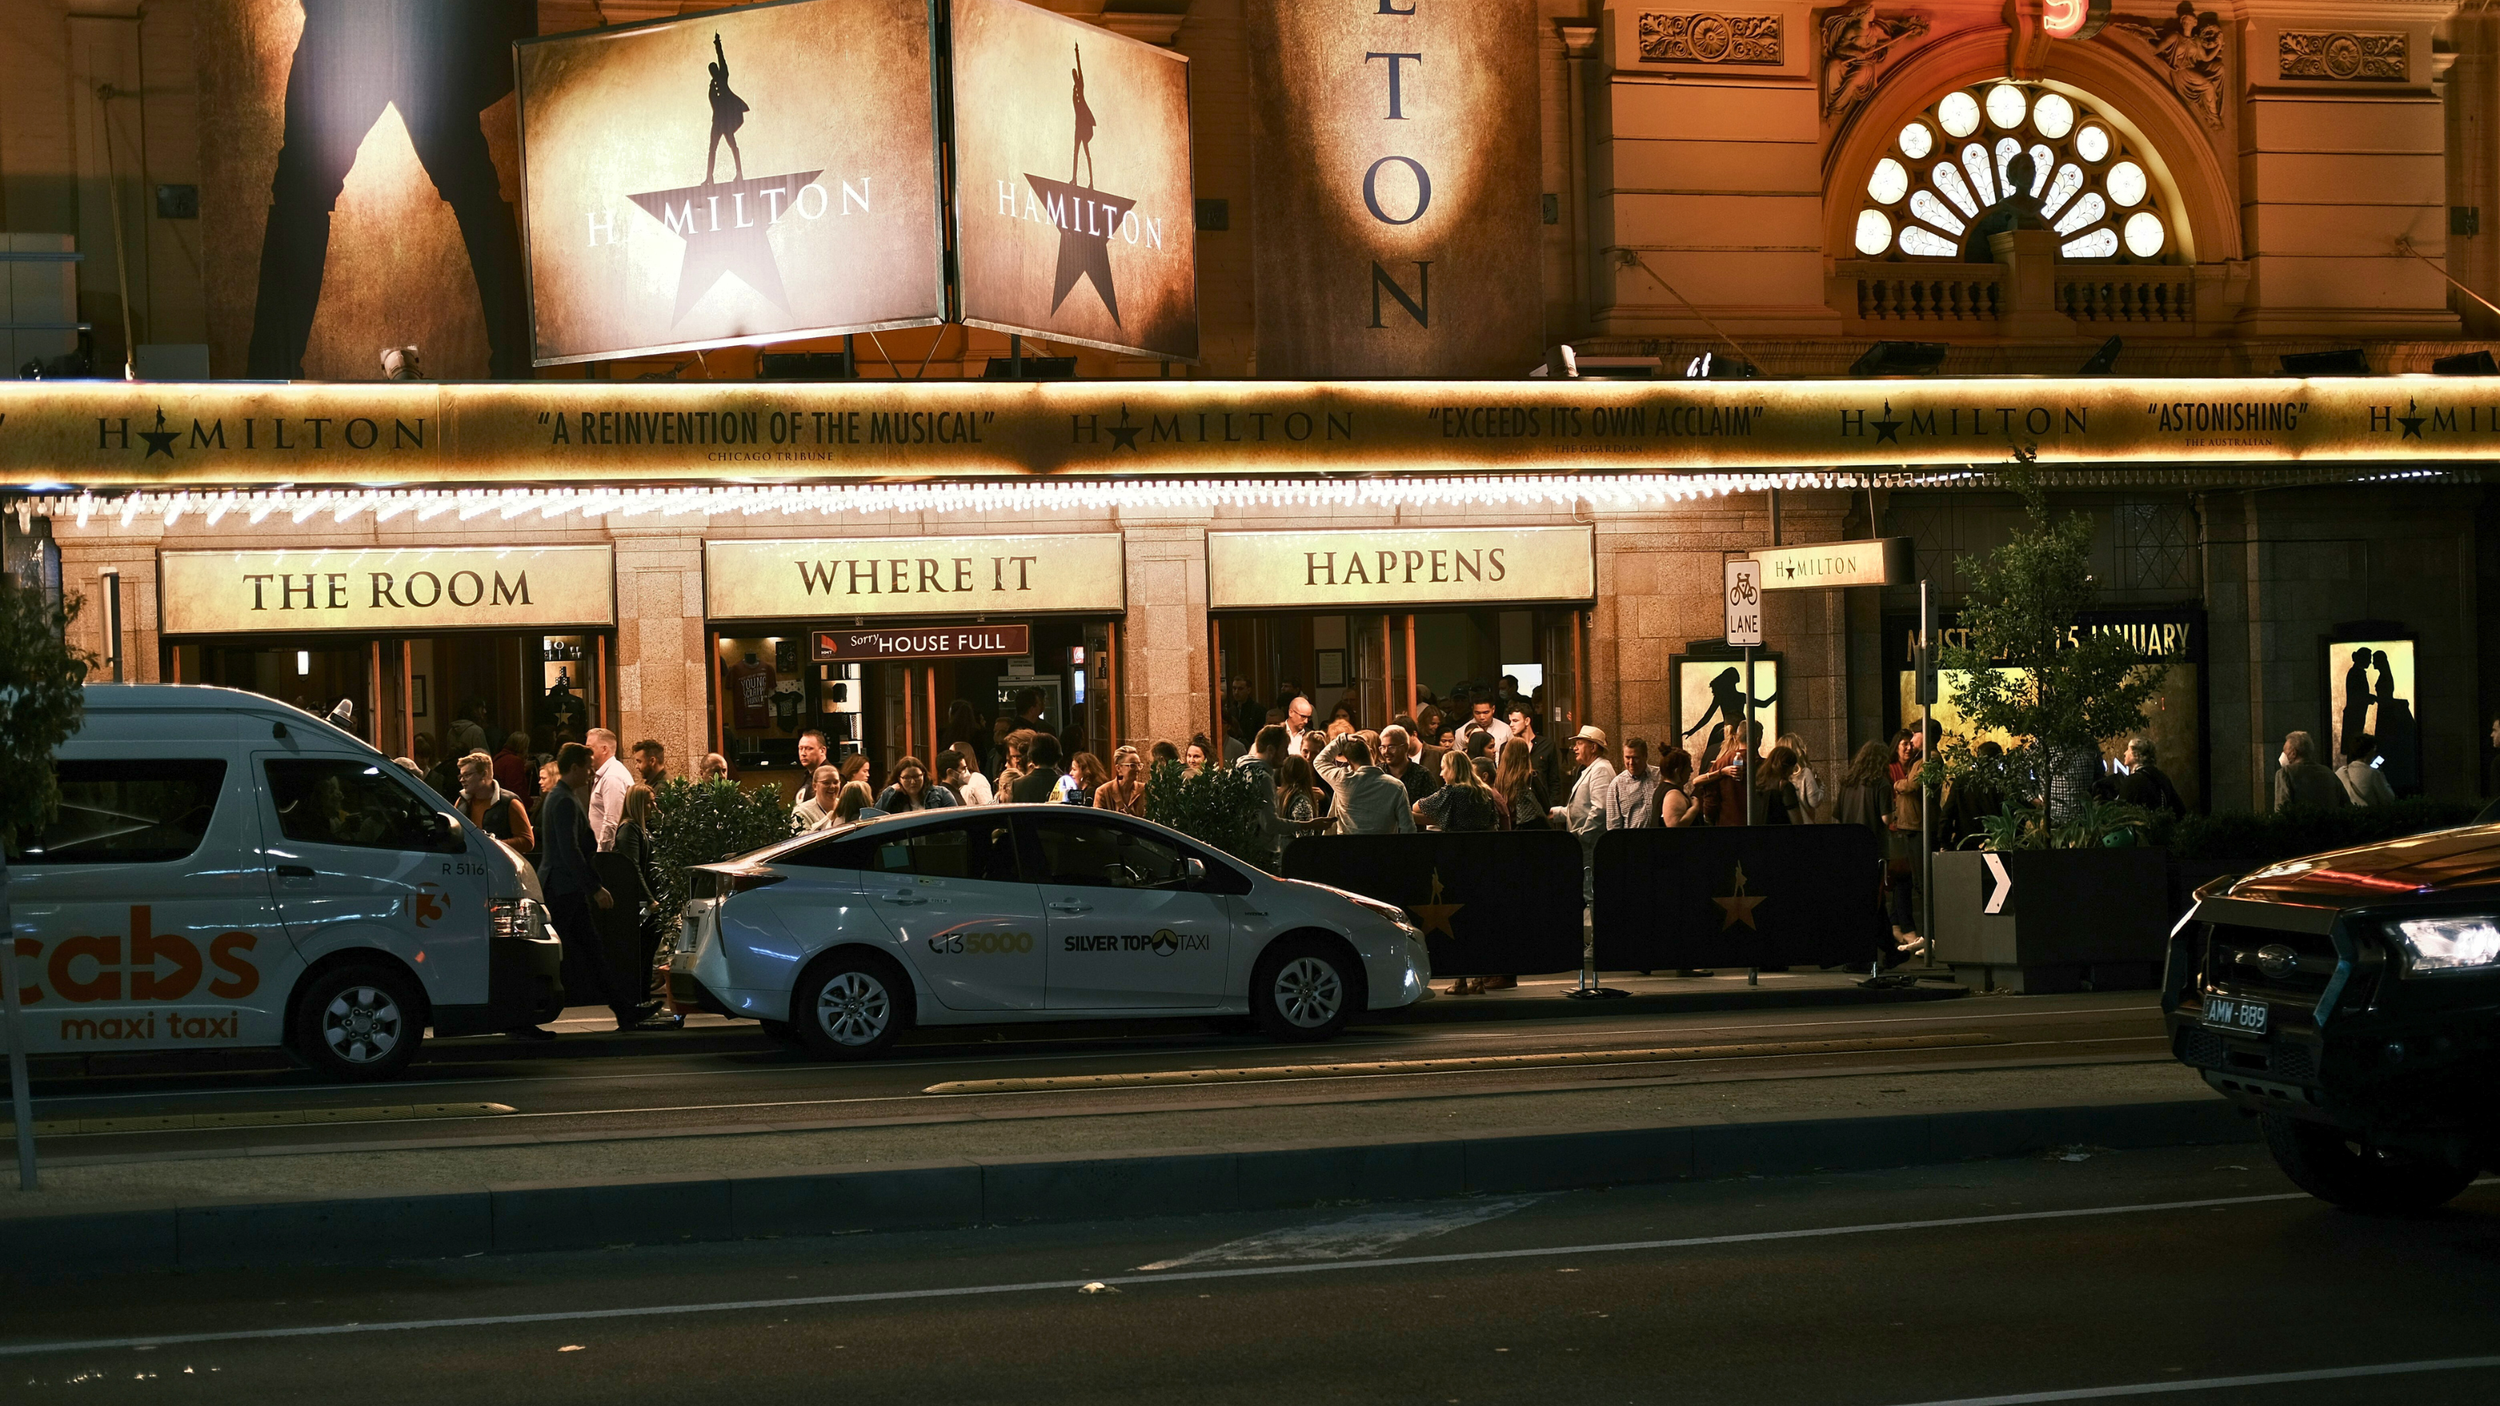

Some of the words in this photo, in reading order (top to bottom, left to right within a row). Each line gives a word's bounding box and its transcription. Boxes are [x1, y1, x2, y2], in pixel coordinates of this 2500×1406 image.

[1362, 0, 1434, 329] TON
[585, 177, 871, 248] HMILTON
[997, 179, 1163, 251] HAMILTON
[581, 412, 758, 445] REINVENTION
[770, 412, 803, 444] OF
[811, 412, 860, 444] THE
[1551, 406, 1582, 438] ITS
[1592, 406, 1646, 438] OWN
[708, 452, 771, 462] CHICAGO
[777, 452, 834, 461] TRIBUNE
[1554, 445, 1576, 453] THE
[1580, 445, 1643, 453] GUARDIAN
[2185, 438, 2205, 447] THE
[2208, 438, 2273, 447] AUSTRALIAN
[795, 557, 974, 596] WHERE
[991, 556, 1037, 591] IT
[1304, 548, 1507, 586] HAPPENS
[243, 572, 349, 610] THE
[367, 569, 534, 608] ROOM
[1730, 615, 1758, 633] LANE
[850, 633, 880, 647] Sorry
[879, 635, 949, 652] HOUSE
[958, 634, 1006, 650] FULL
[442, 863, 451, 875] R
[456, 863, 485, 876] 5116
[1064, 934, 1120, 952] SILVER
[1121, 934, 1153, 951] TOP
[1177, 935, 1210, 951] TAXI
[61, 1011, 155, 1040] maxi
[167, 1010, 238, 1039] taxi
